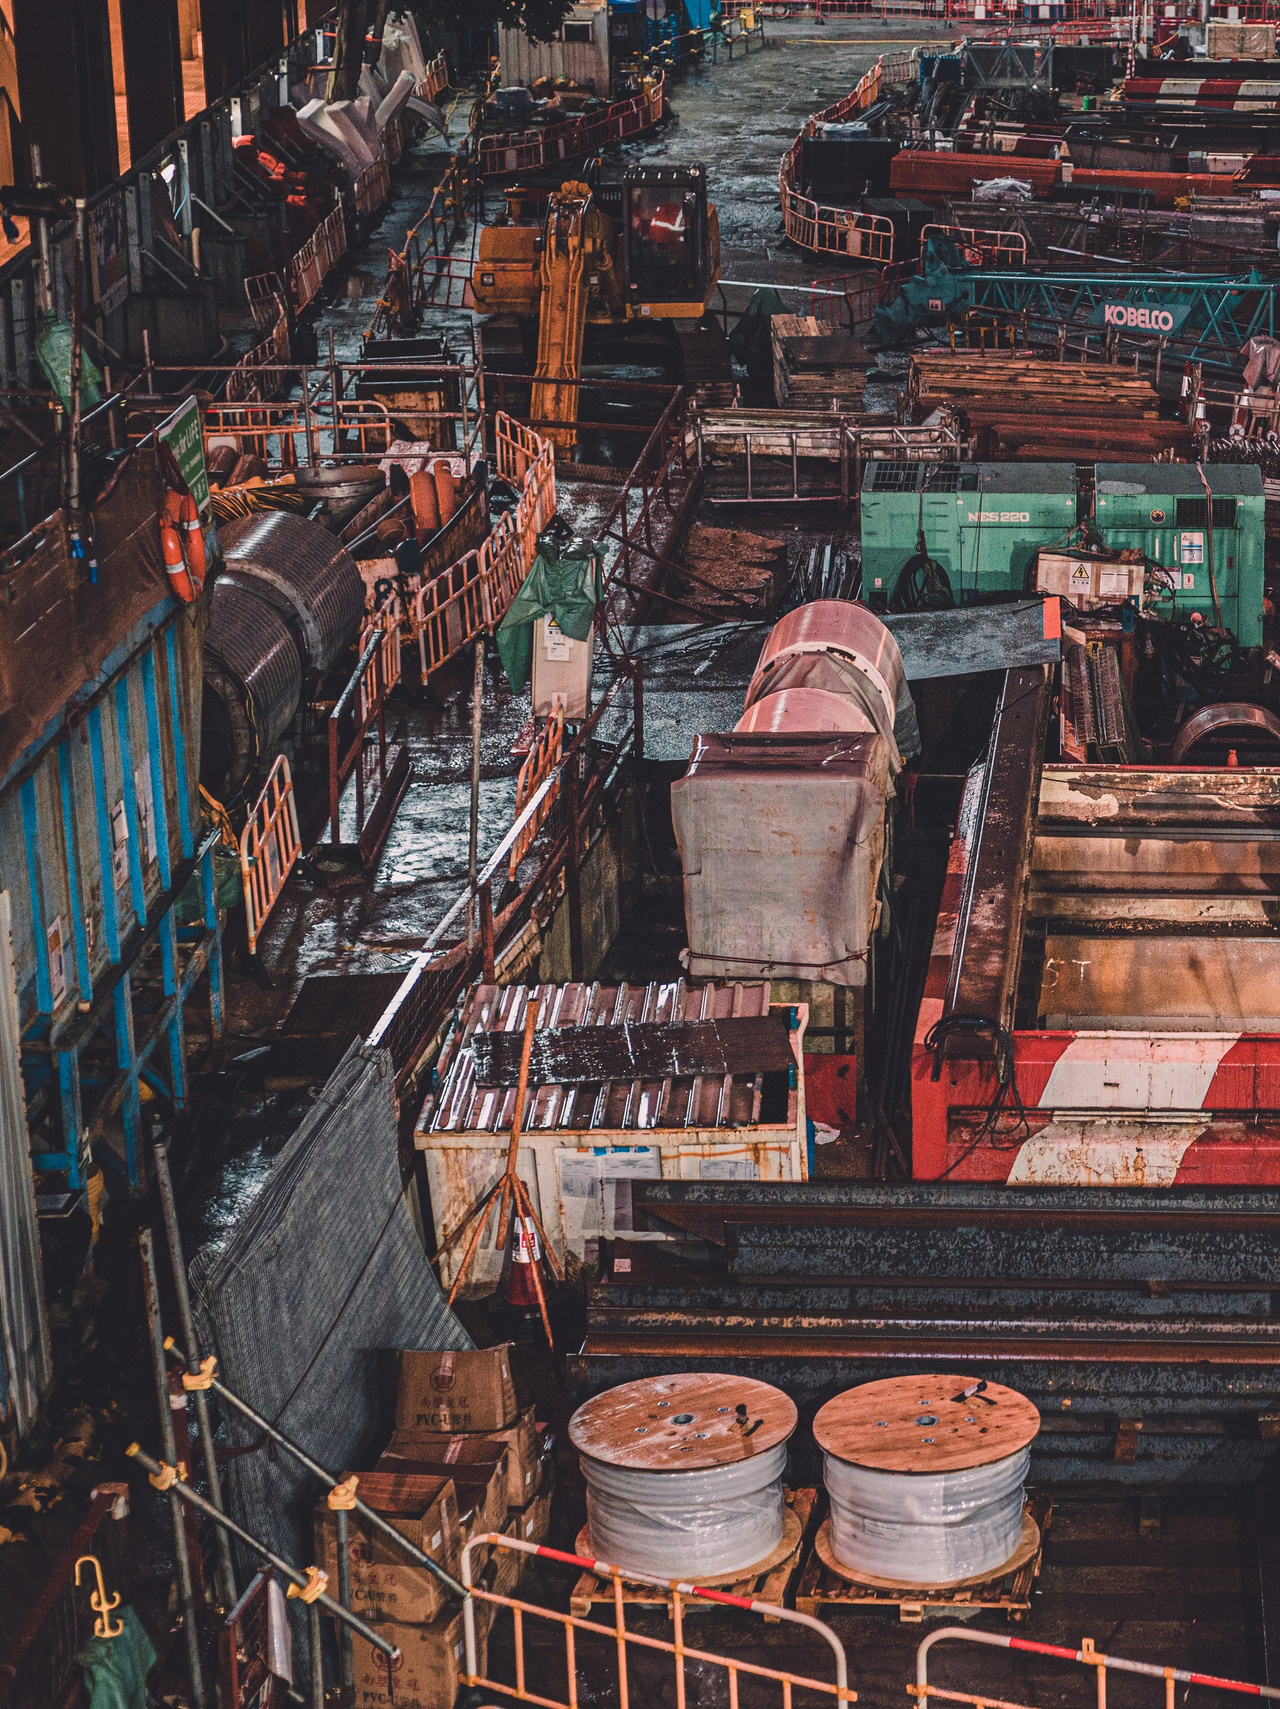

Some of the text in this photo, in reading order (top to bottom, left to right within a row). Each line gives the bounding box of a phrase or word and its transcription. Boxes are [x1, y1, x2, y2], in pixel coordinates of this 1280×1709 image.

[1104, 304, 1174, 331] KOBELCO
[968, 511, 1029, 522] NES 220
